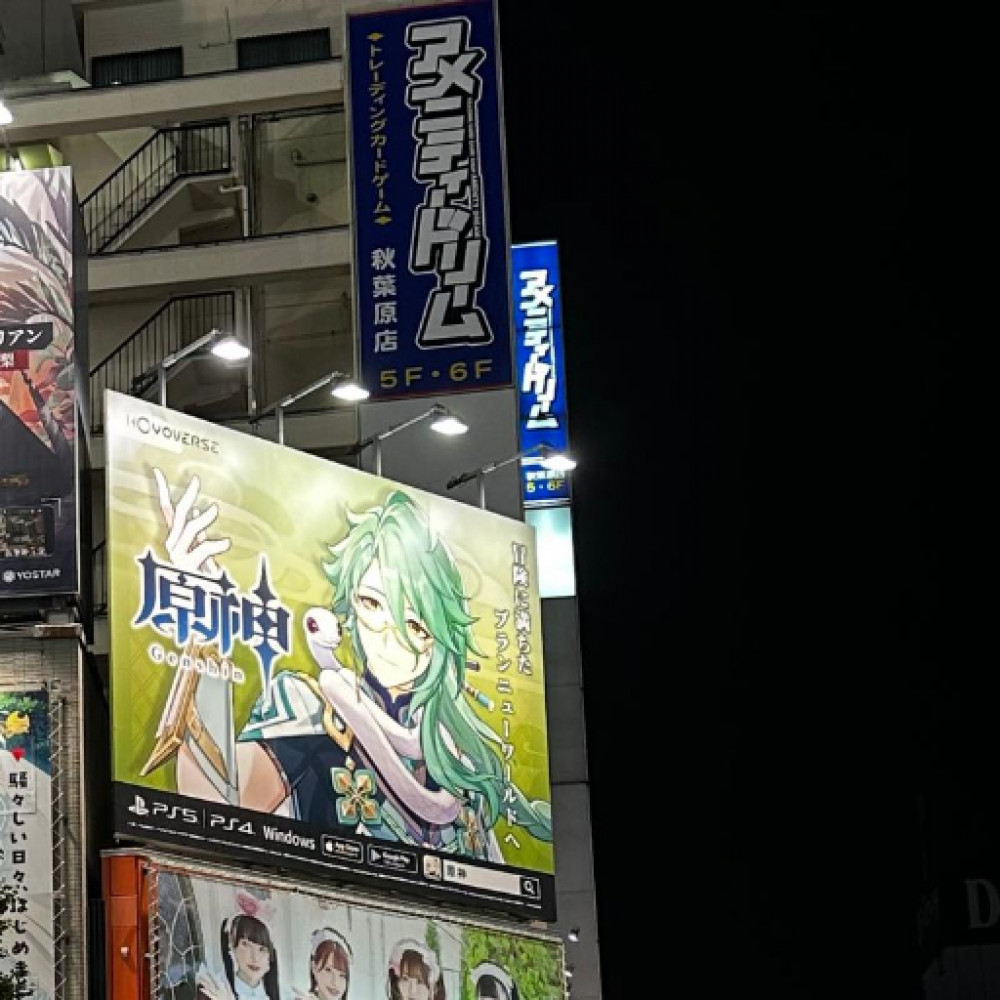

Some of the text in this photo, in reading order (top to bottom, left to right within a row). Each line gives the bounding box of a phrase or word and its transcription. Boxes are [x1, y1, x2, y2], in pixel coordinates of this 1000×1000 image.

[368, 45, 390, 215] トレーディングカードゲーム
[371, 247, 398, 353] 秋葉原店
[16, 567, 62, 581] YOSTAR
[131, 547, 293, 700] 原神
[152, 801, 199, 825] PS5
[209, 813, 256, 836] PS4
[262, 824, 317, 851] Windows
